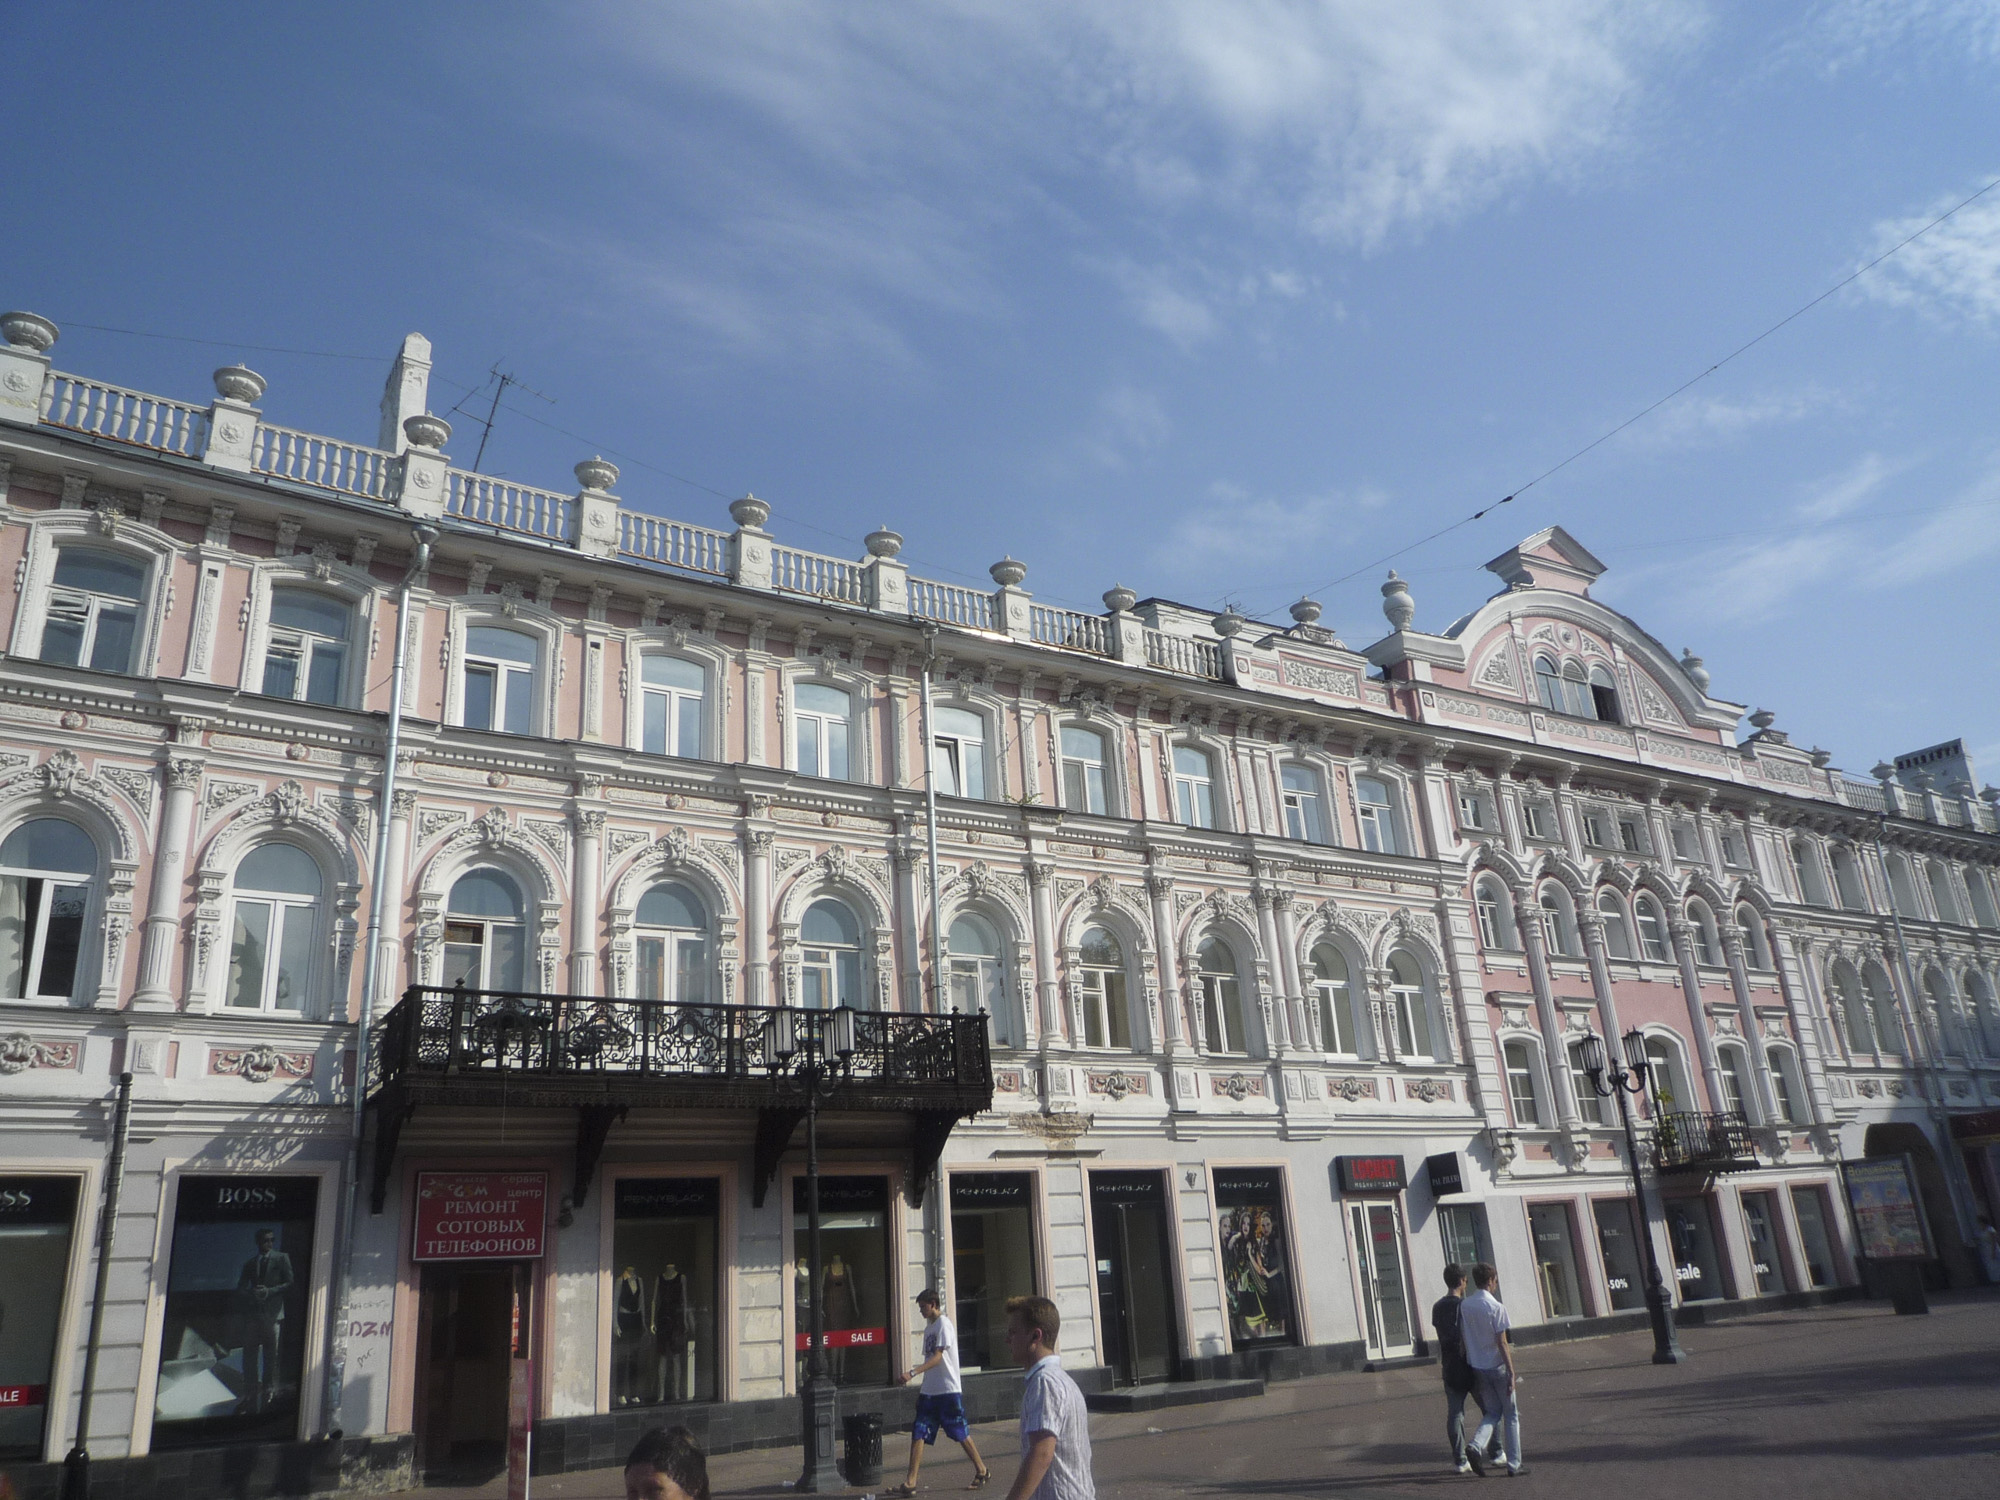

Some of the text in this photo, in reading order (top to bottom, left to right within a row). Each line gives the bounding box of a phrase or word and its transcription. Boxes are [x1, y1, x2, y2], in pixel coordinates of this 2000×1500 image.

[503, 1175, 543, 1185] сервис
[0, 1189, 32, 1207] SS
[217, 1187, 277, 1204] BOSS
[507, 1189, 542, 1199] центр
[444, 1200, 519, 1214] РЕМОНТ
[436, 1219, 526, 1234] СОТОВЫХ
[425, 1238, 536, 1254] ТЕЛЕФОНОВ
[1676, 1263, 1701, 1281] sale
[806, 1335, 829, 1346] SE
[851, 1332, 873, 1343] SALE
